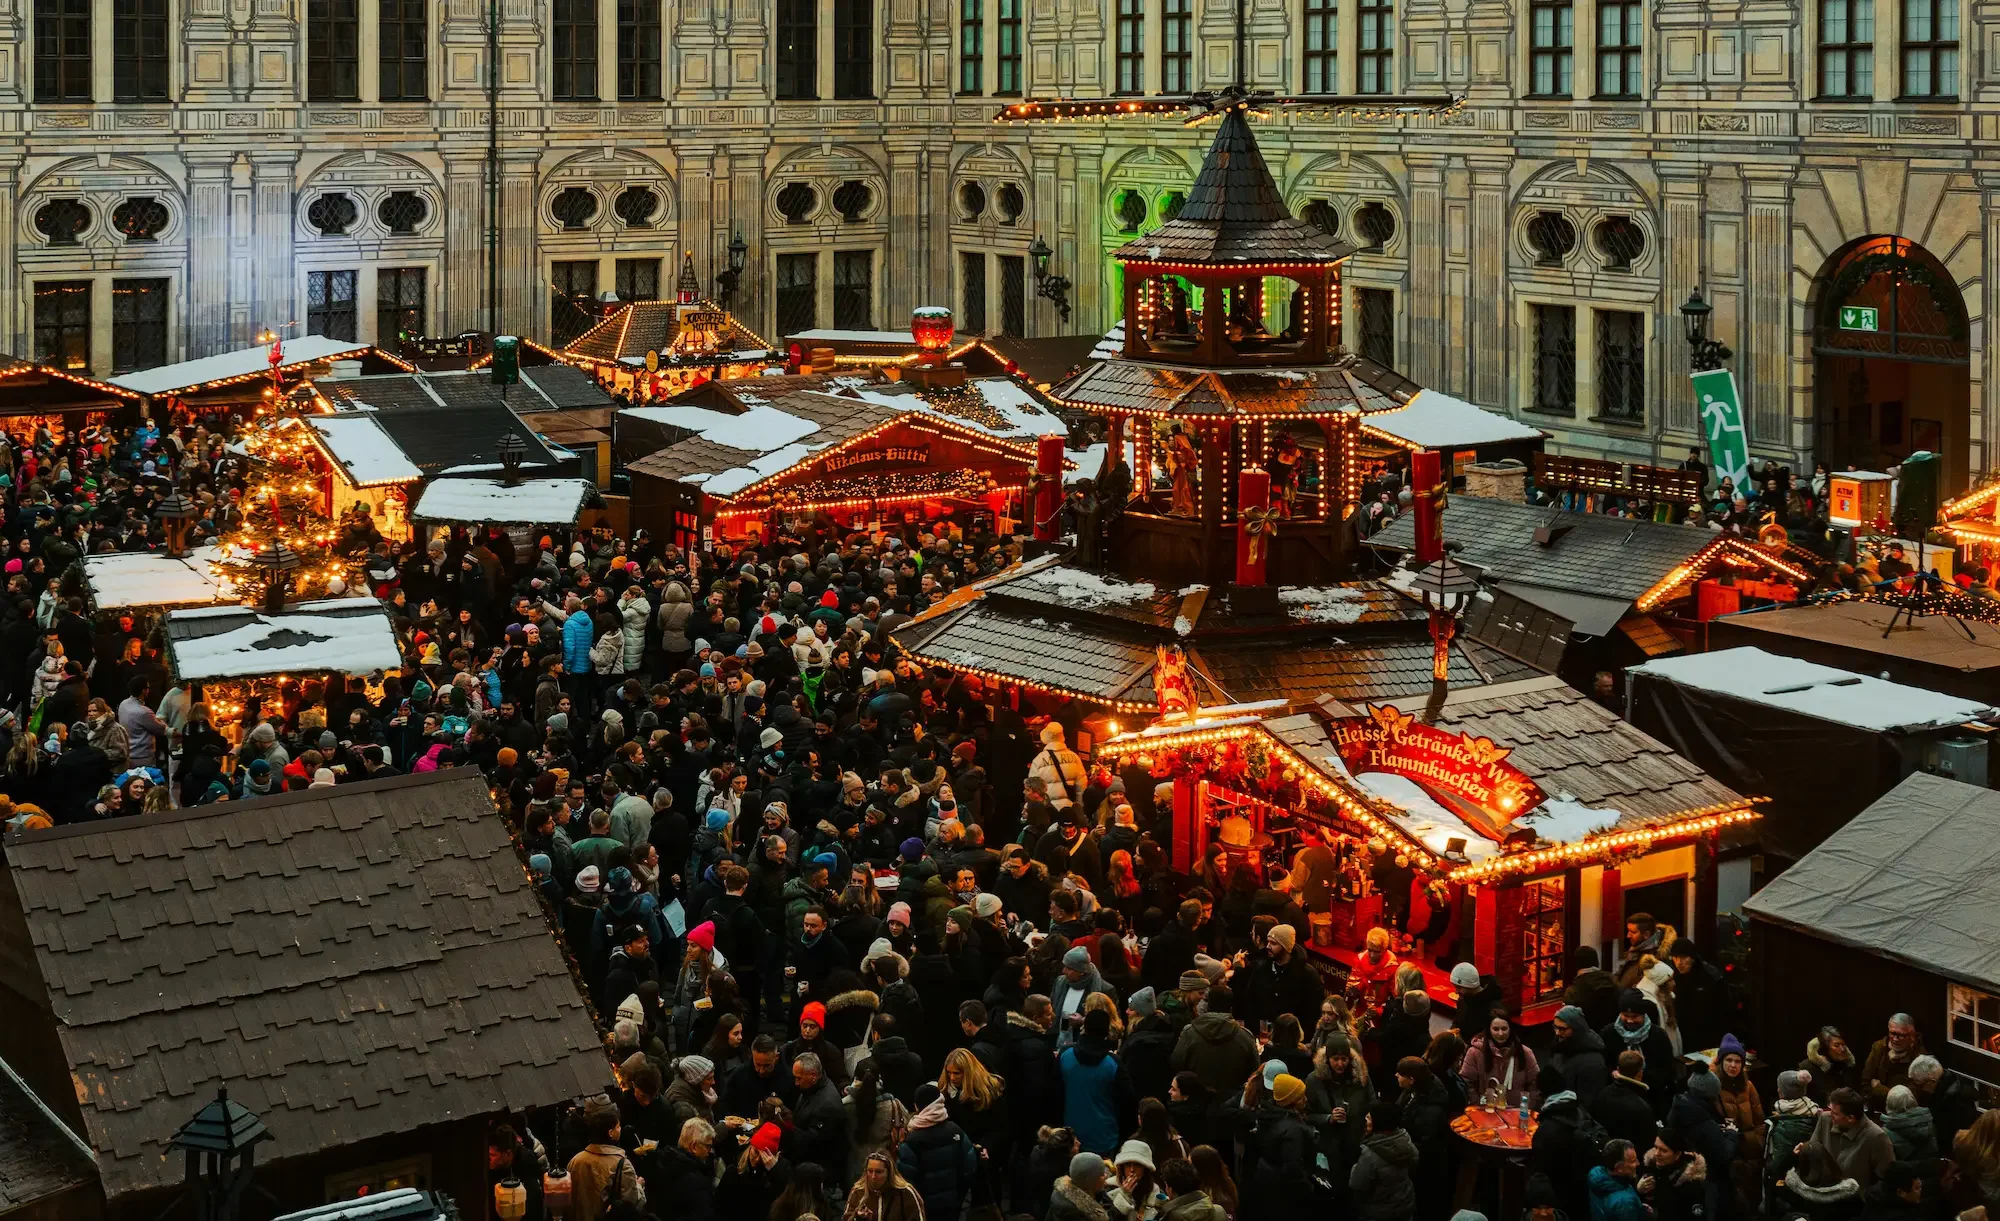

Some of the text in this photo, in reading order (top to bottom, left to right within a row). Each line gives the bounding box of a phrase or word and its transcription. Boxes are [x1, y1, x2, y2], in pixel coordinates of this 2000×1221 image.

[1836, 488, 1854, 496] ATM
[1335, 726, 1390, 746] Heisse
[1394, 727, 1472, 765] Getränke
[1487, 762, 1530, 806] Wein
[1370, 749, 1490, 802] Flammkuchen
